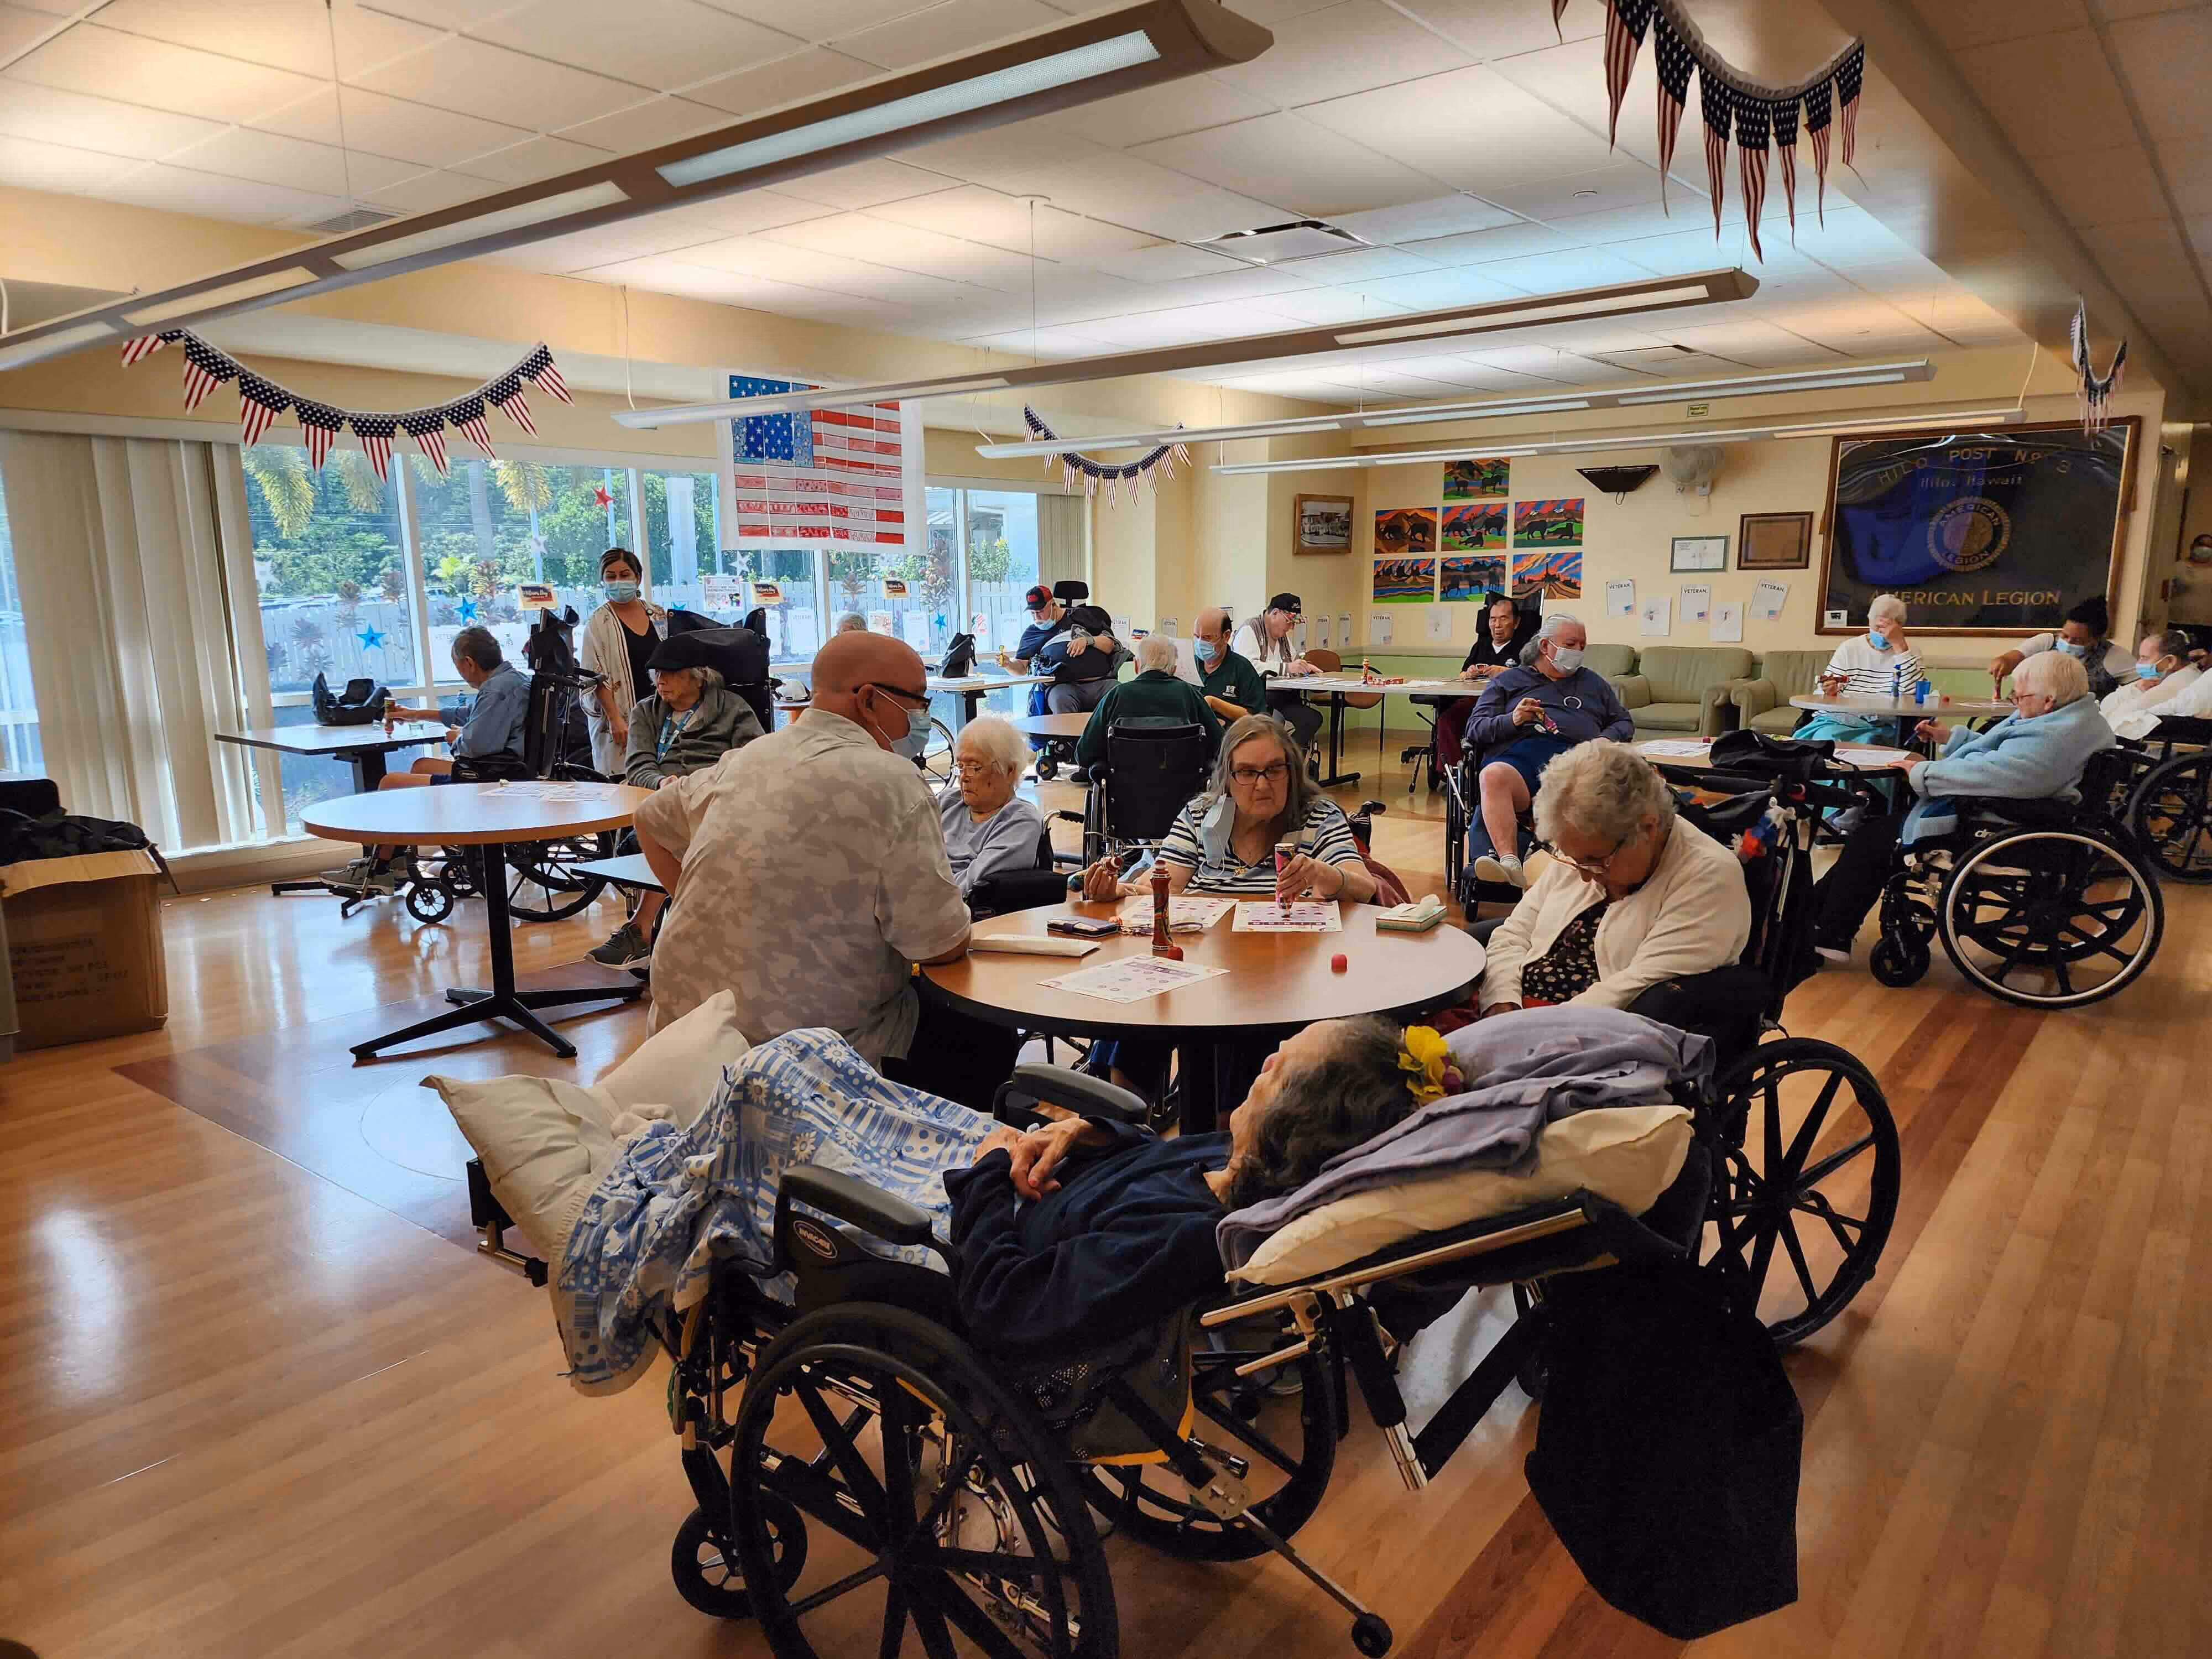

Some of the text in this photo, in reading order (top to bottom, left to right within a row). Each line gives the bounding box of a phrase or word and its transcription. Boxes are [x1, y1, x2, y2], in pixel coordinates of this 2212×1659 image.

[1879, 457, 1928, 486] HILO
[1949, 447, 1999, 462] POST
[1940, 503, 2000, 526] AMERICAN
[1982, 588, 2061, 606] LEGION
